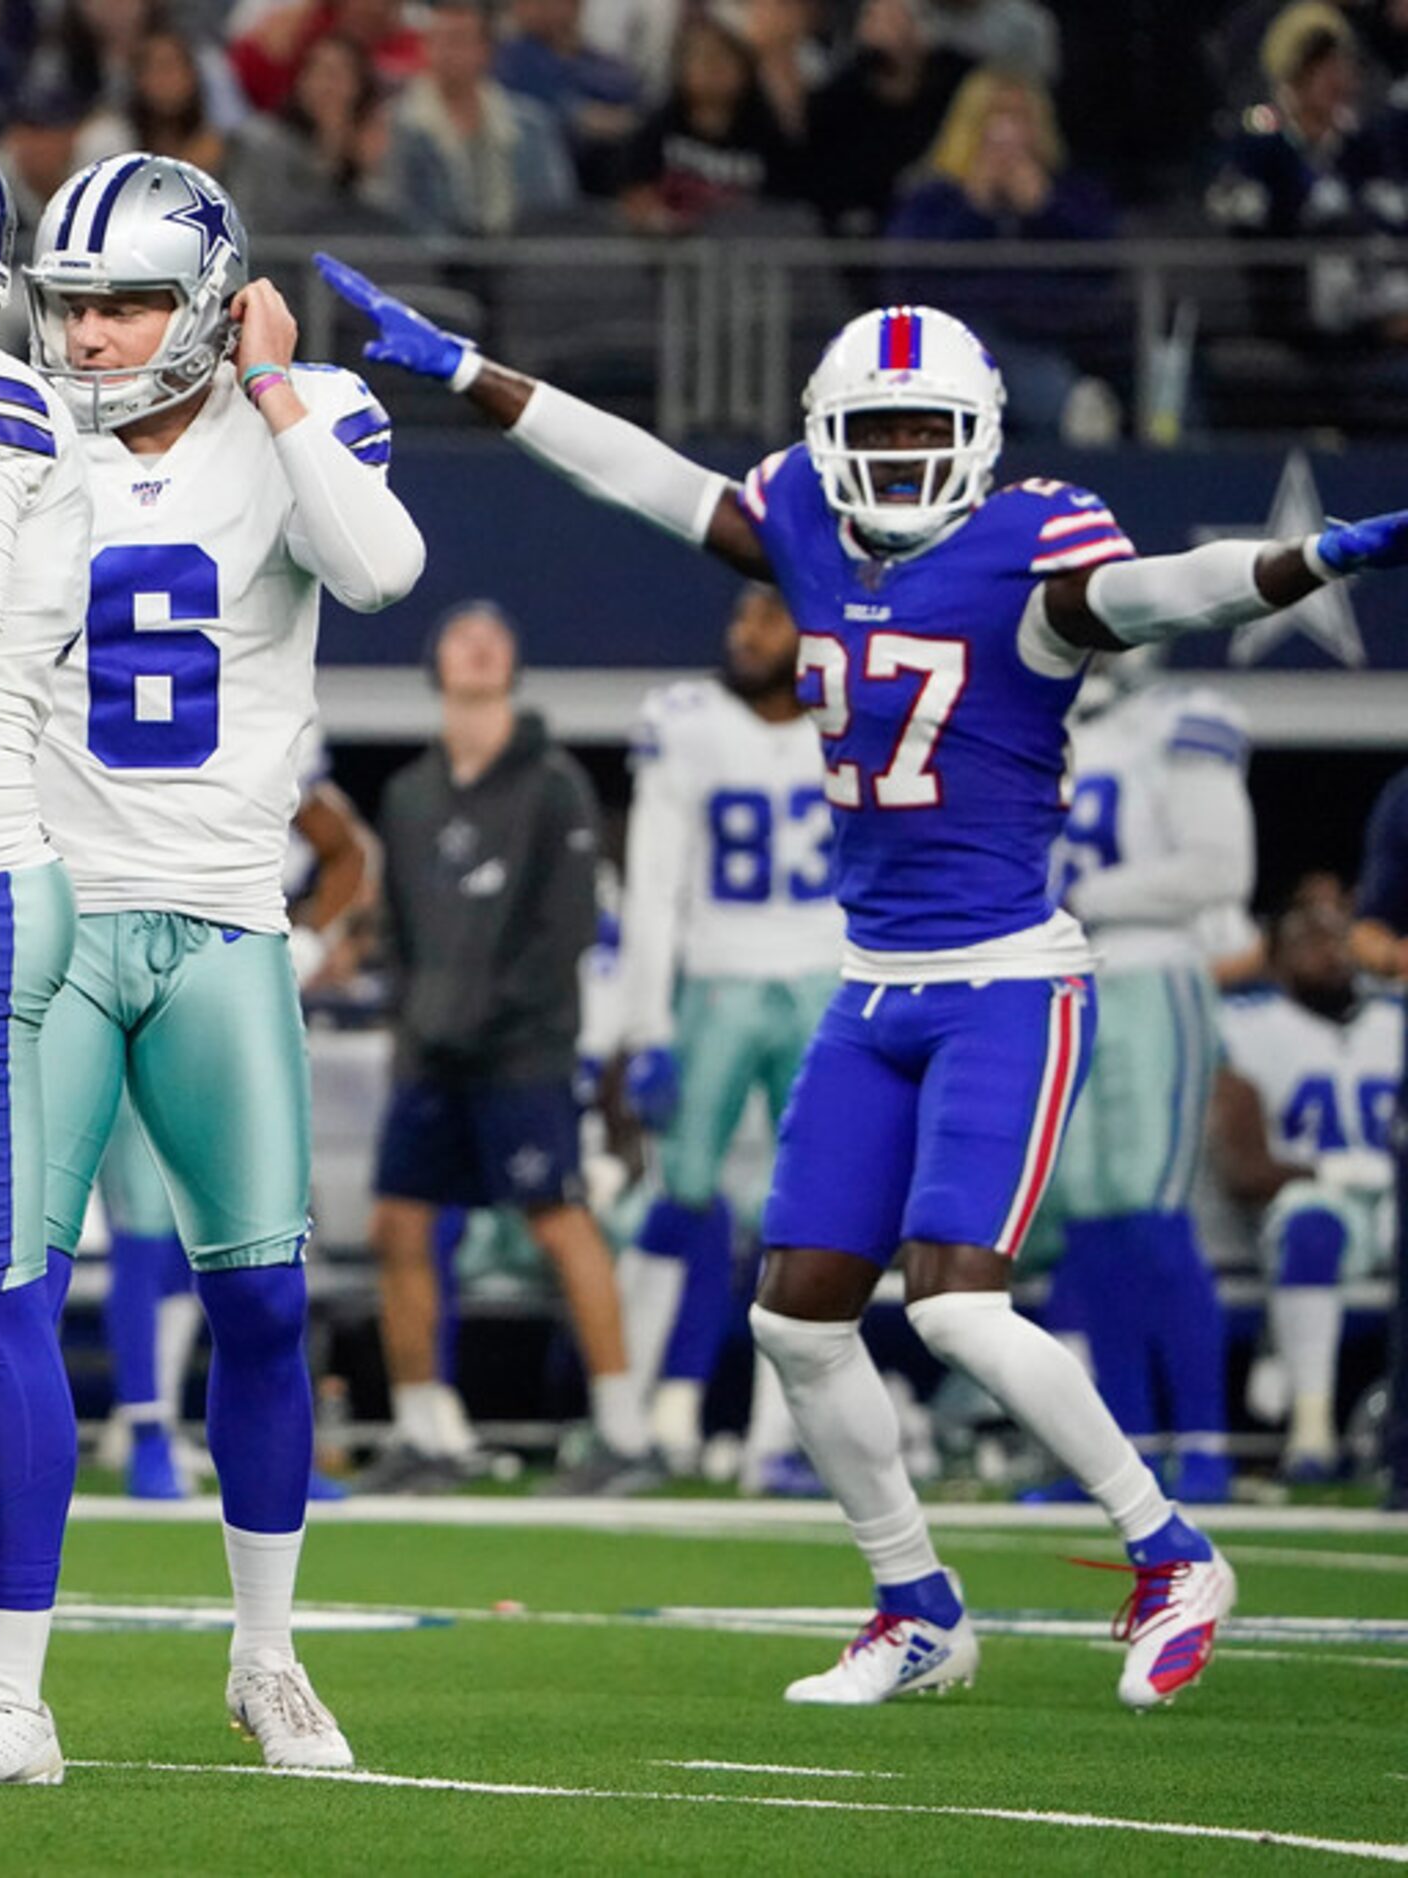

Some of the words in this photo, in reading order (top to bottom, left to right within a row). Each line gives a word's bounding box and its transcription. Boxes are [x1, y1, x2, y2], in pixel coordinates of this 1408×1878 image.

[85, 543, 221, 769] 6
[795, 631, 970, 810] 27
[709, 784, 840, 903] 83
